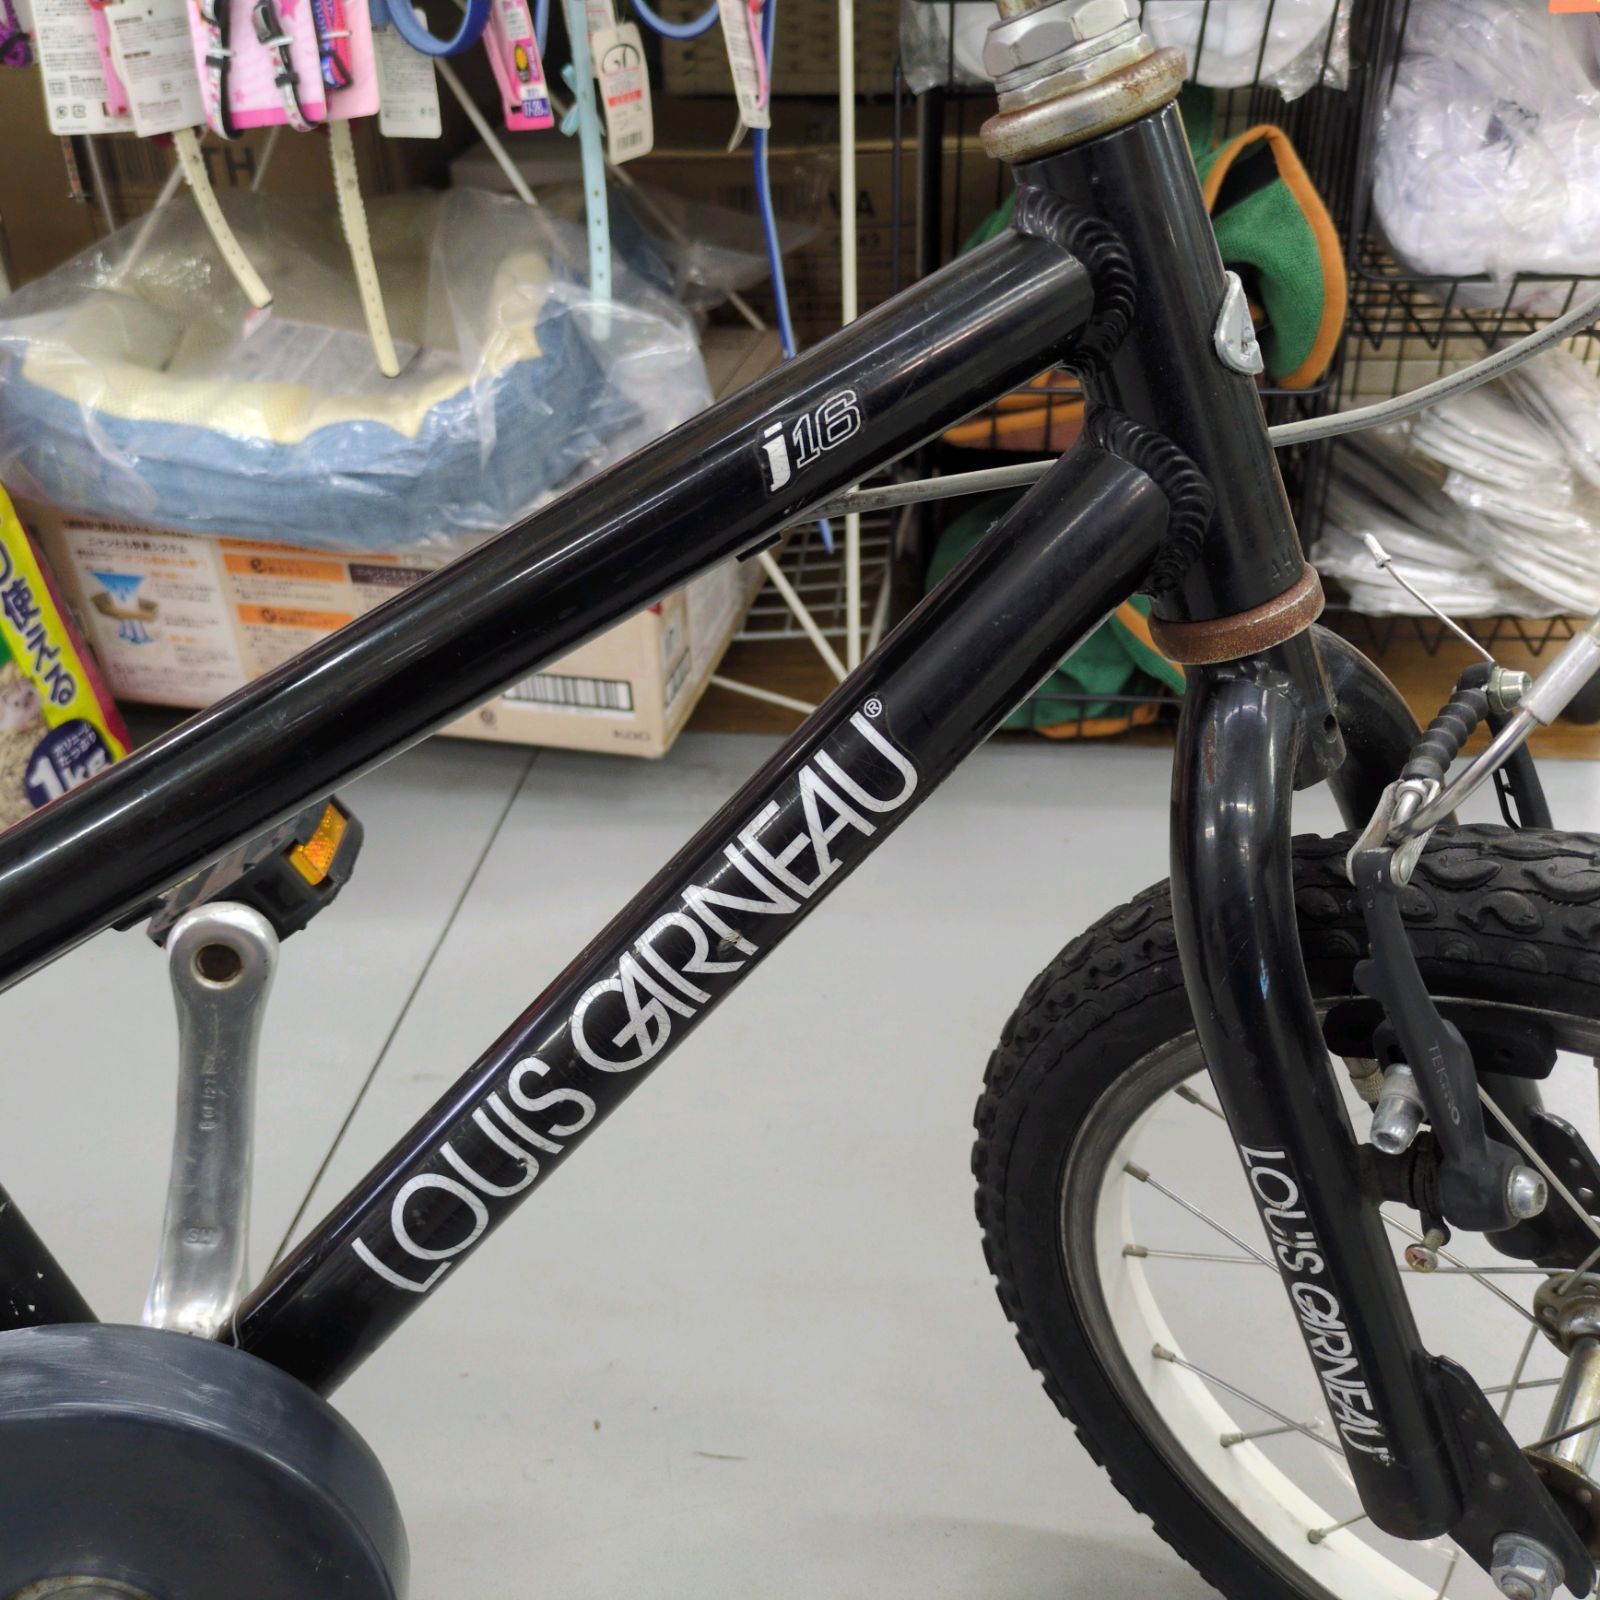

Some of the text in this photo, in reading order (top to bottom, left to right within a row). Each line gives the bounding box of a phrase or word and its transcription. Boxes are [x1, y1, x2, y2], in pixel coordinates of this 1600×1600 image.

[762, 389, 861, 492] j16
[352, 1056, 597, 1293] LOUIS
[1240, 1144, 1325, 1275] LOUIS
